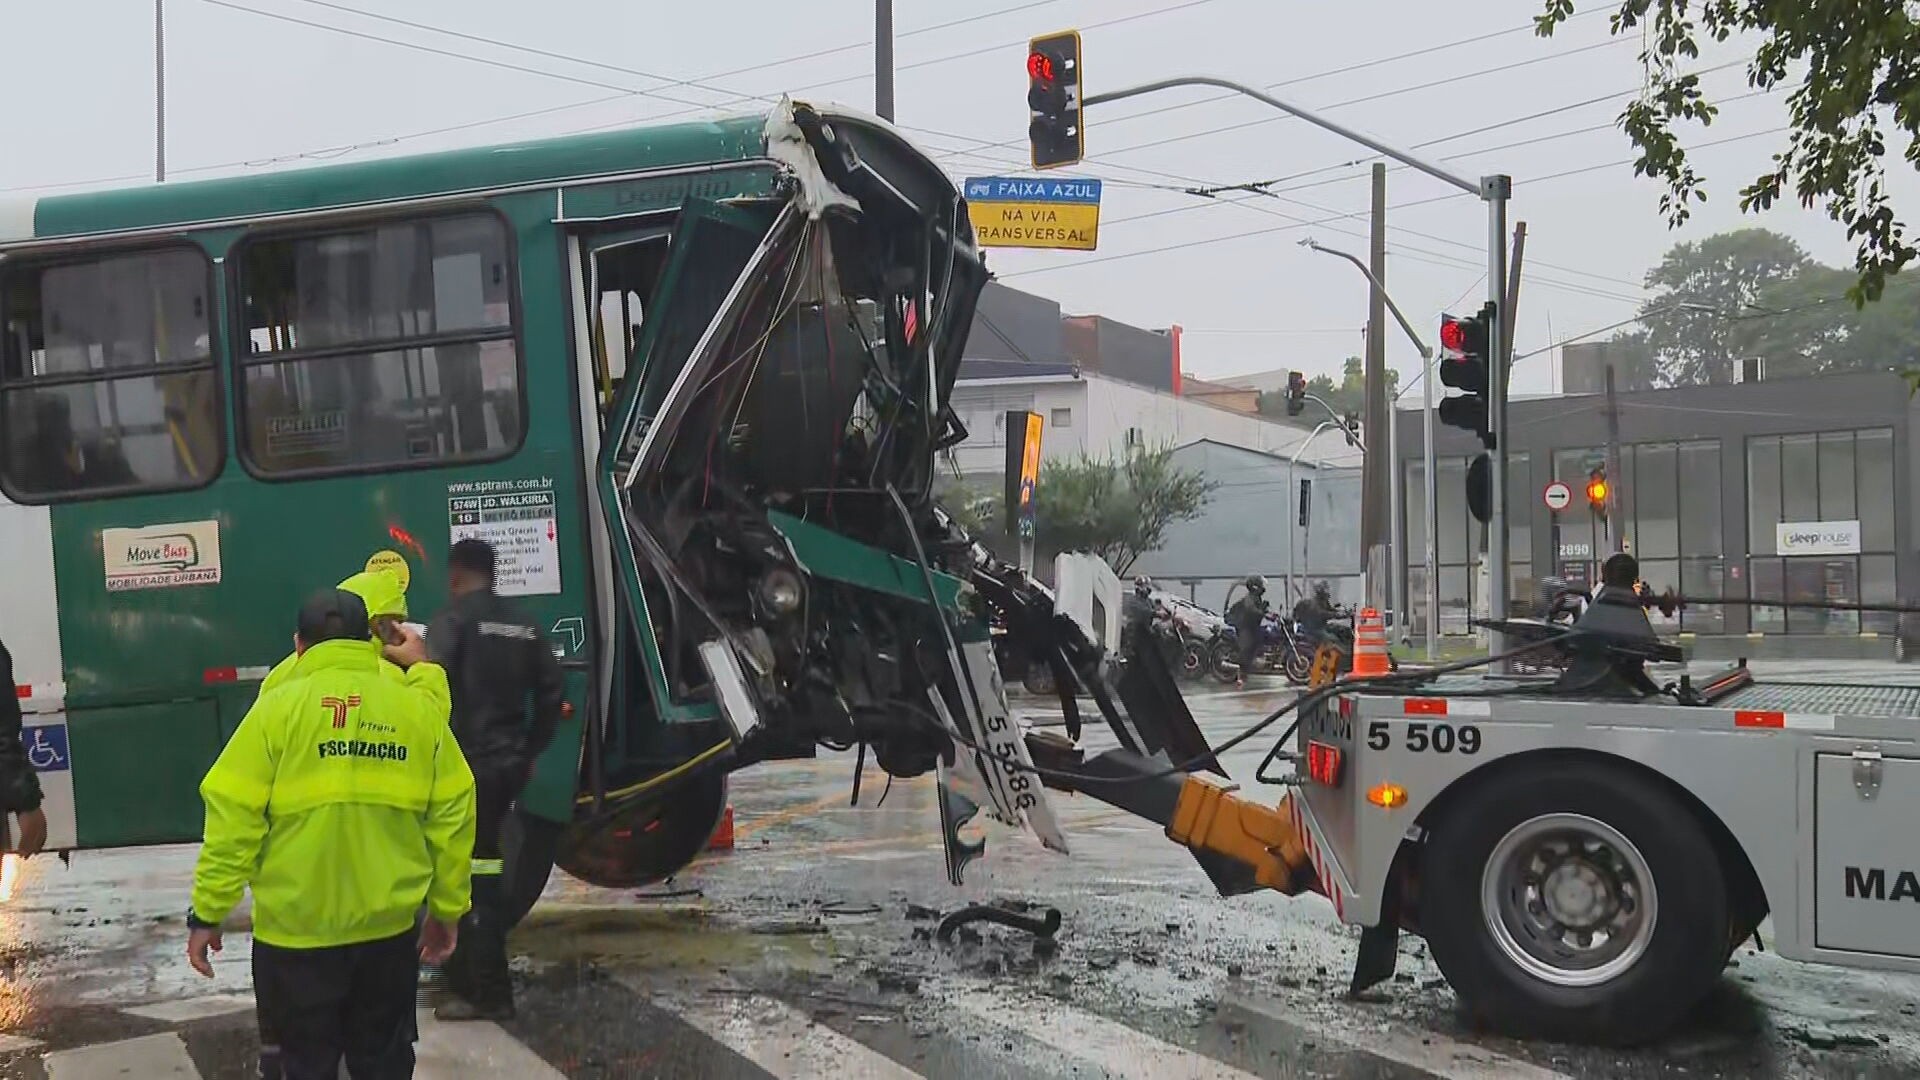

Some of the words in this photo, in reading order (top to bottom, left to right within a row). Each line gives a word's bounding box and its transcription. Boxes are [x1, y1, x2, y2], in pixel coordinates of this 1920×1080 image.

[999, 183, 1046, 196] FAIXA
[1052, 184, 1097, 198] AZUL
[1002, 209, 1023, 222] NA
[1031, 210, 1057, 223] VIA
[448, 476, 553, 493] www.sptrans.com.br
[483, 498, 499, 508] JD.
[501, 494, 549, 507] WALKIRIA
[127, 545, 161, 562] Move
[107, 575, 171, 588] MOBILIDADE
[174, 571, 218, 583] URBANA
[988, 716, 1008, 733] 5
[1367, 721, 1391, 751] 5
[1405, 722, 1482, 755] 509
